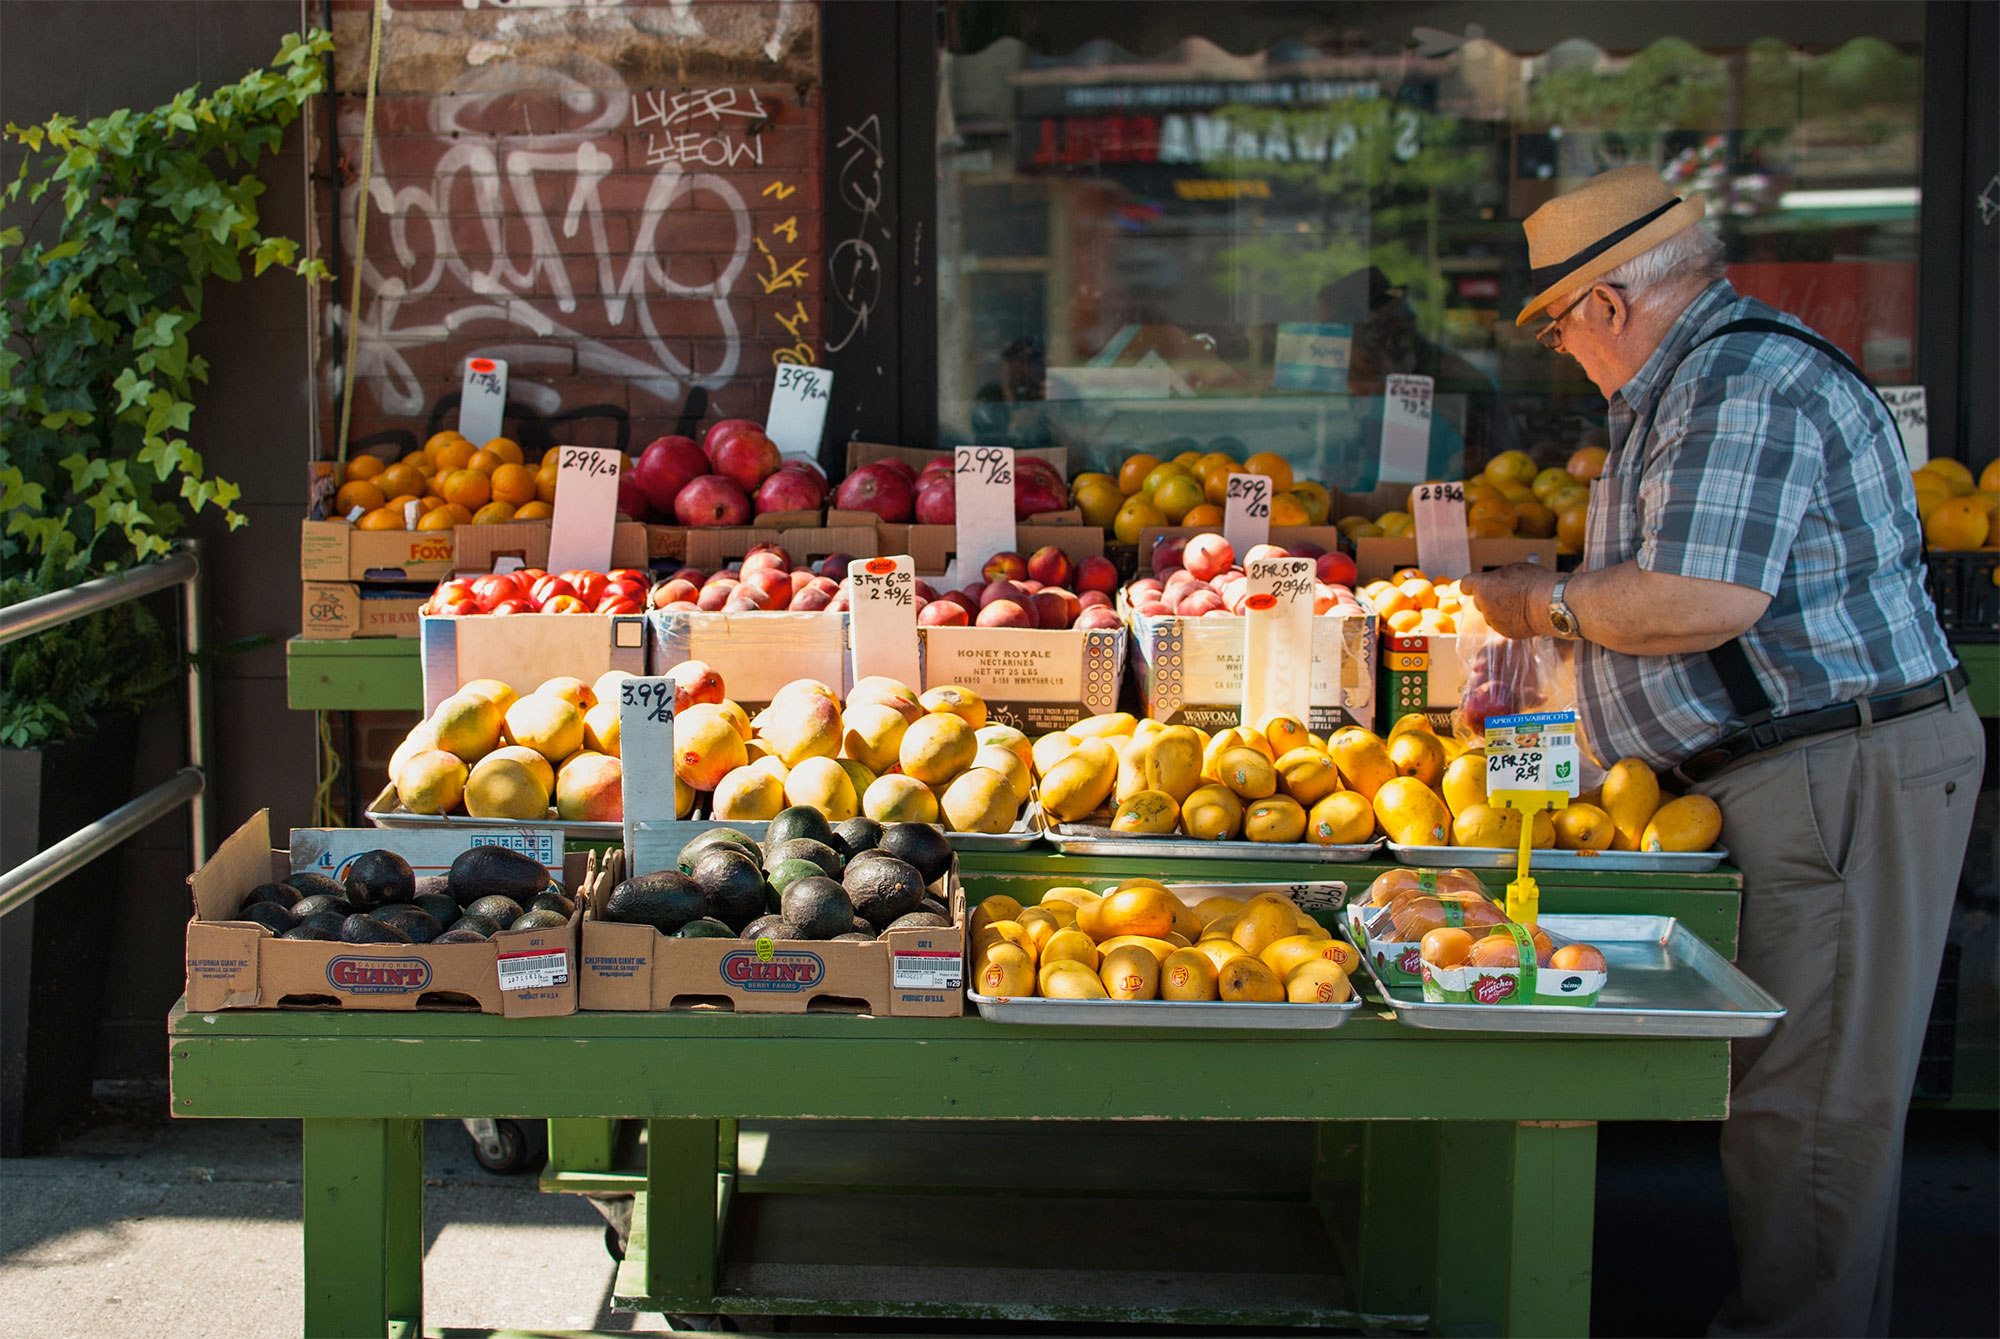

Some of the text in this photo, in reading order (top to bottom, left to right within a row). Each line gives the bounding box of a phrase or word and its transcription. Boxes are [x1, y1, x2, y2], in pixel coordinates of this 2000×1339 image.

[957, 447, 1012, 485] 2.99/LB
[1251, 563, 1261, 579] 2
[853, 574, 864, 586] 3
[309, 603, 345, 618] GPC
[957, 650, 1052, 659] HONEY ROYALE
[980, 659, 1035, 667] NECTARINES
[973, 668, 992, 676] NET
[995, 668, 1006, 676] WT
[1183, 711, 1239, 722] WAWONA
[1489, 756, 1501, 772] 2
[515, 839, 522, 847] 21
[541, 839, 549, 848] 15
[541, 852, 549, 861] 16
[619, 957, 635, 965] GIANT
[333, 961, 424, 986] GIANT
[727, 957, 816, 982] GIANT
